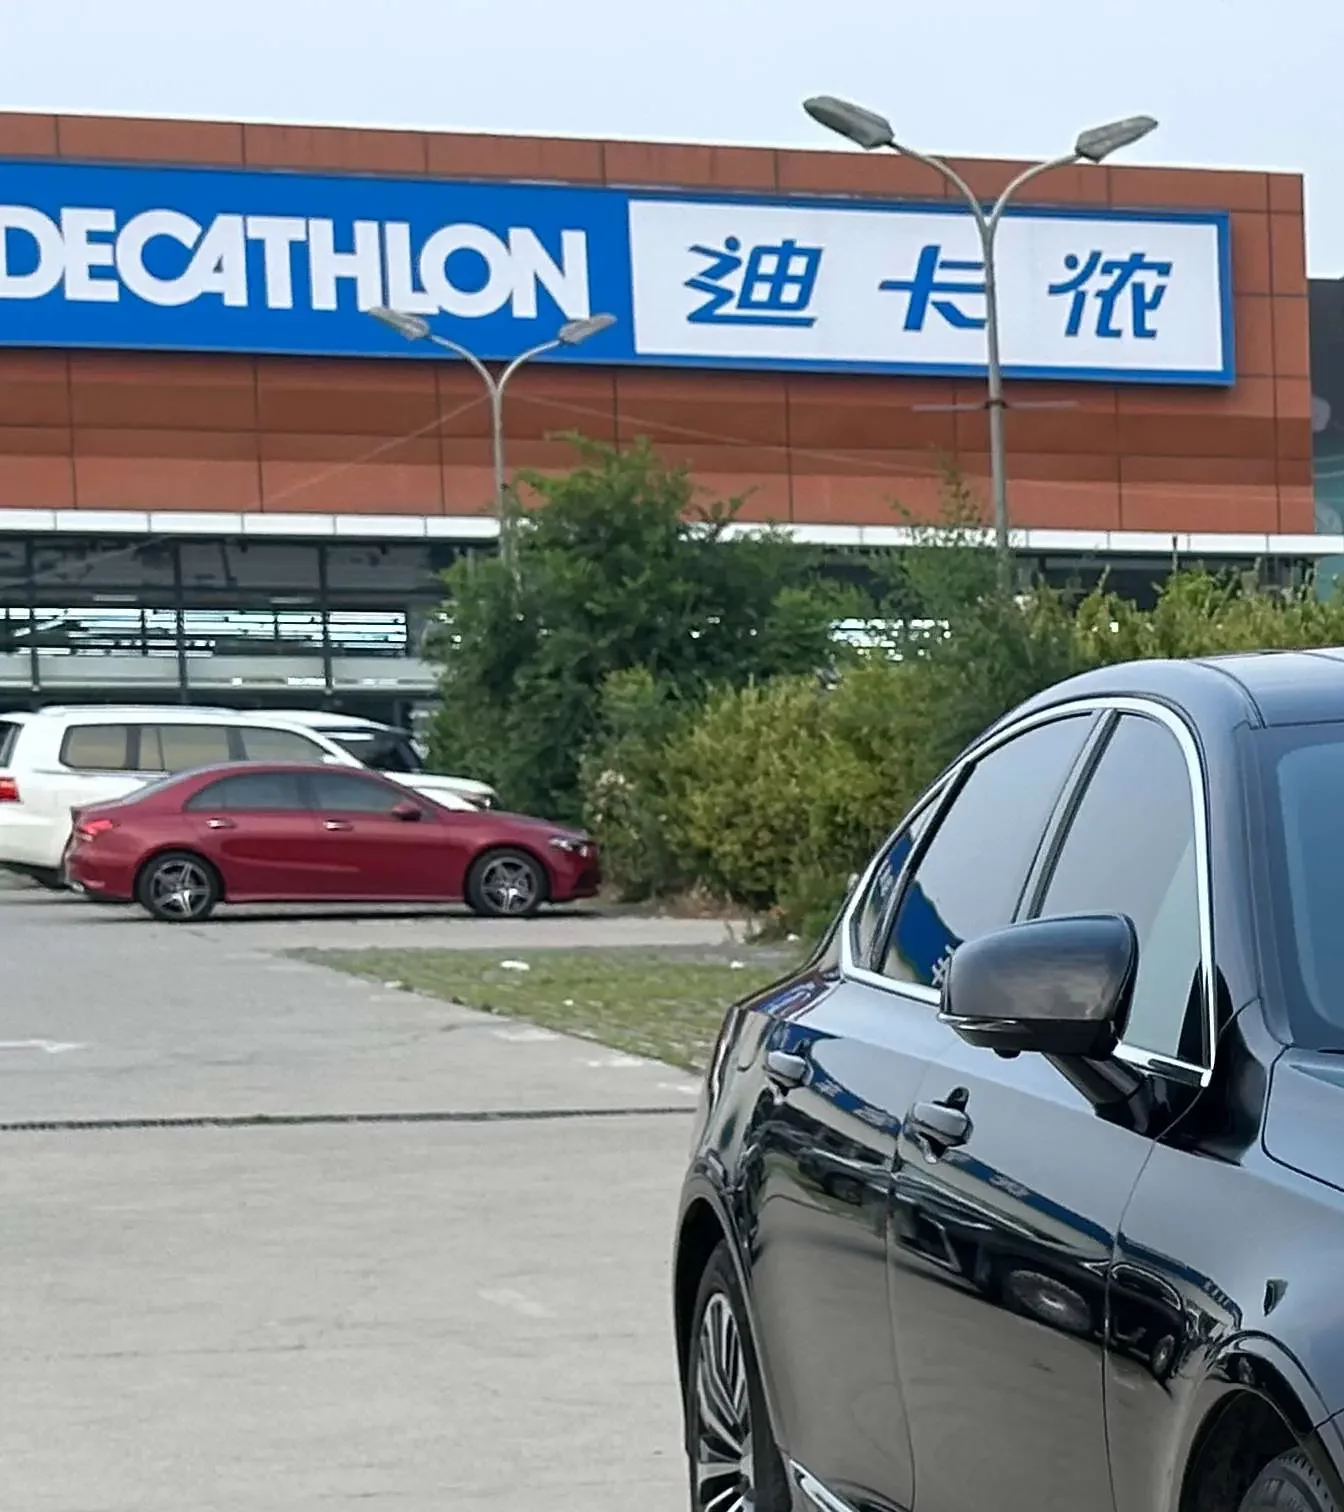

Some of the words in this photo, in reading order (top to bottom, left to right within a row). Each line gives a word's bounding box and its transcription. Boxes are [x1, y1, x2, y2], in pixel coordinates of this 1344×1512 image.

[0, 205, 591, 320] DECATHLON
[682, 235, 1173, 339] 迪卡侬
